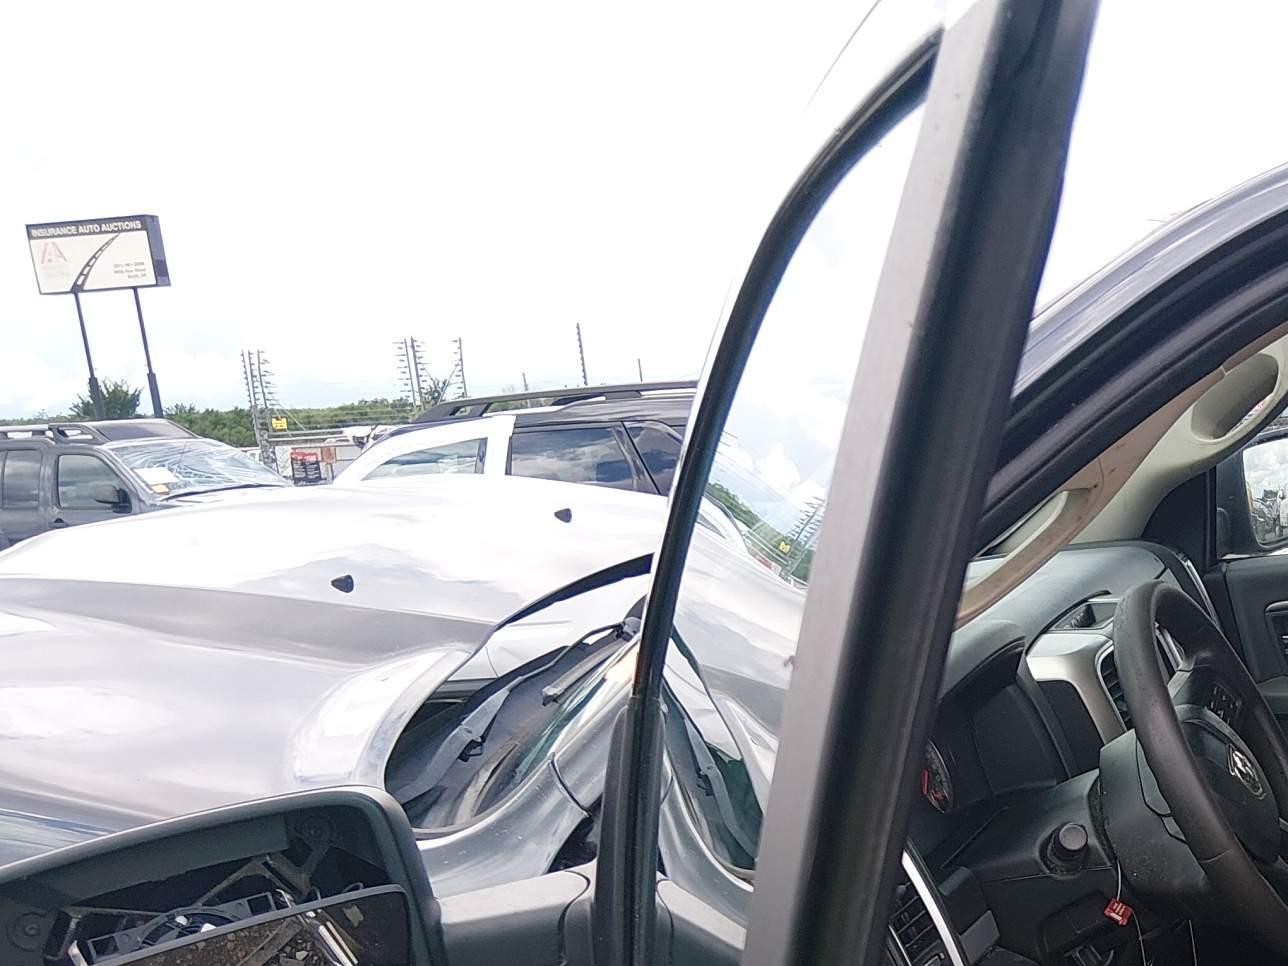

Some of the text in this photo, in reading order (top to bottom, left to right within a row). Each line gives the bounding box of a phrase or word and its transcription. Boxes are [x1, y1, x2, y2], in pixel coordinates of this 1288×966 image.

[31, 220, 142, 238] INSURANCE AUTO AUCTIONS
